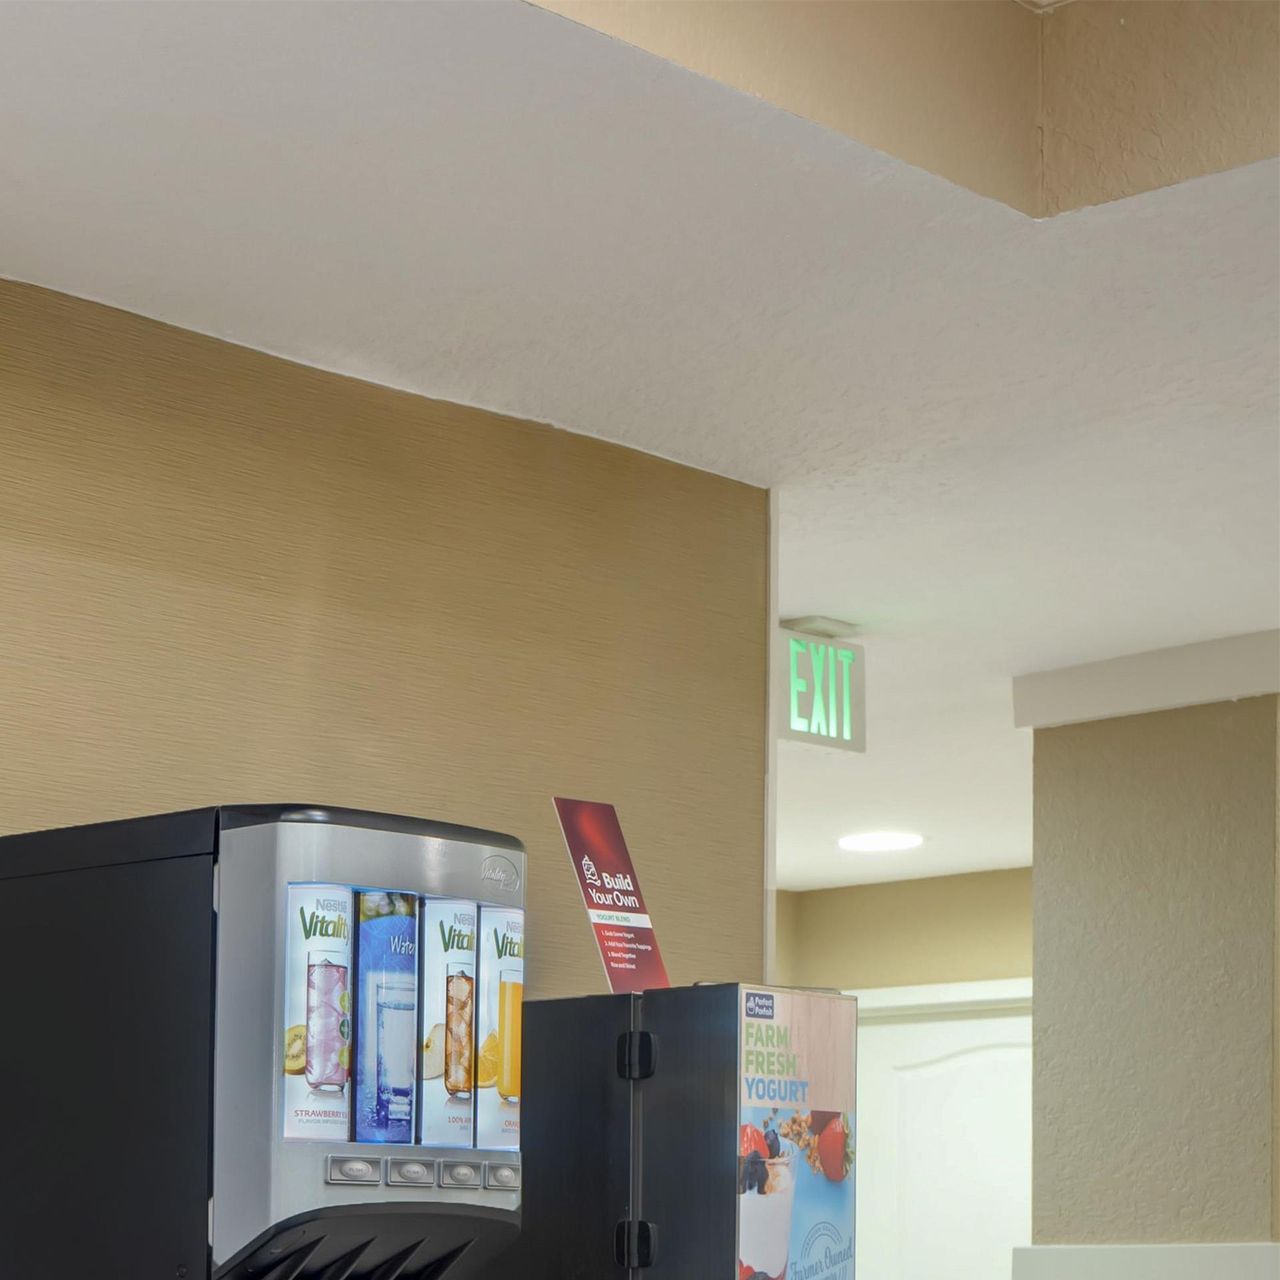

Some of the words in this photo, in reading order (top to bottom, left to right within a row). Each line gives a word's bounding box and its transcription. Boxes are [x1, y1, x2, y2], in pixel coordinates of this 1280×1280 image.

[790, 638, 855, 741] EXIT
[601, 872, 634, 891] Build
[588, 888, 613, 905] Your
[613, 891, 639, 908] Own
[744, 1022, 789, 1049] FARM
[744, 1049, 797, 1077] FRESH
[743, 1077, 809, 1103] YOGURT
